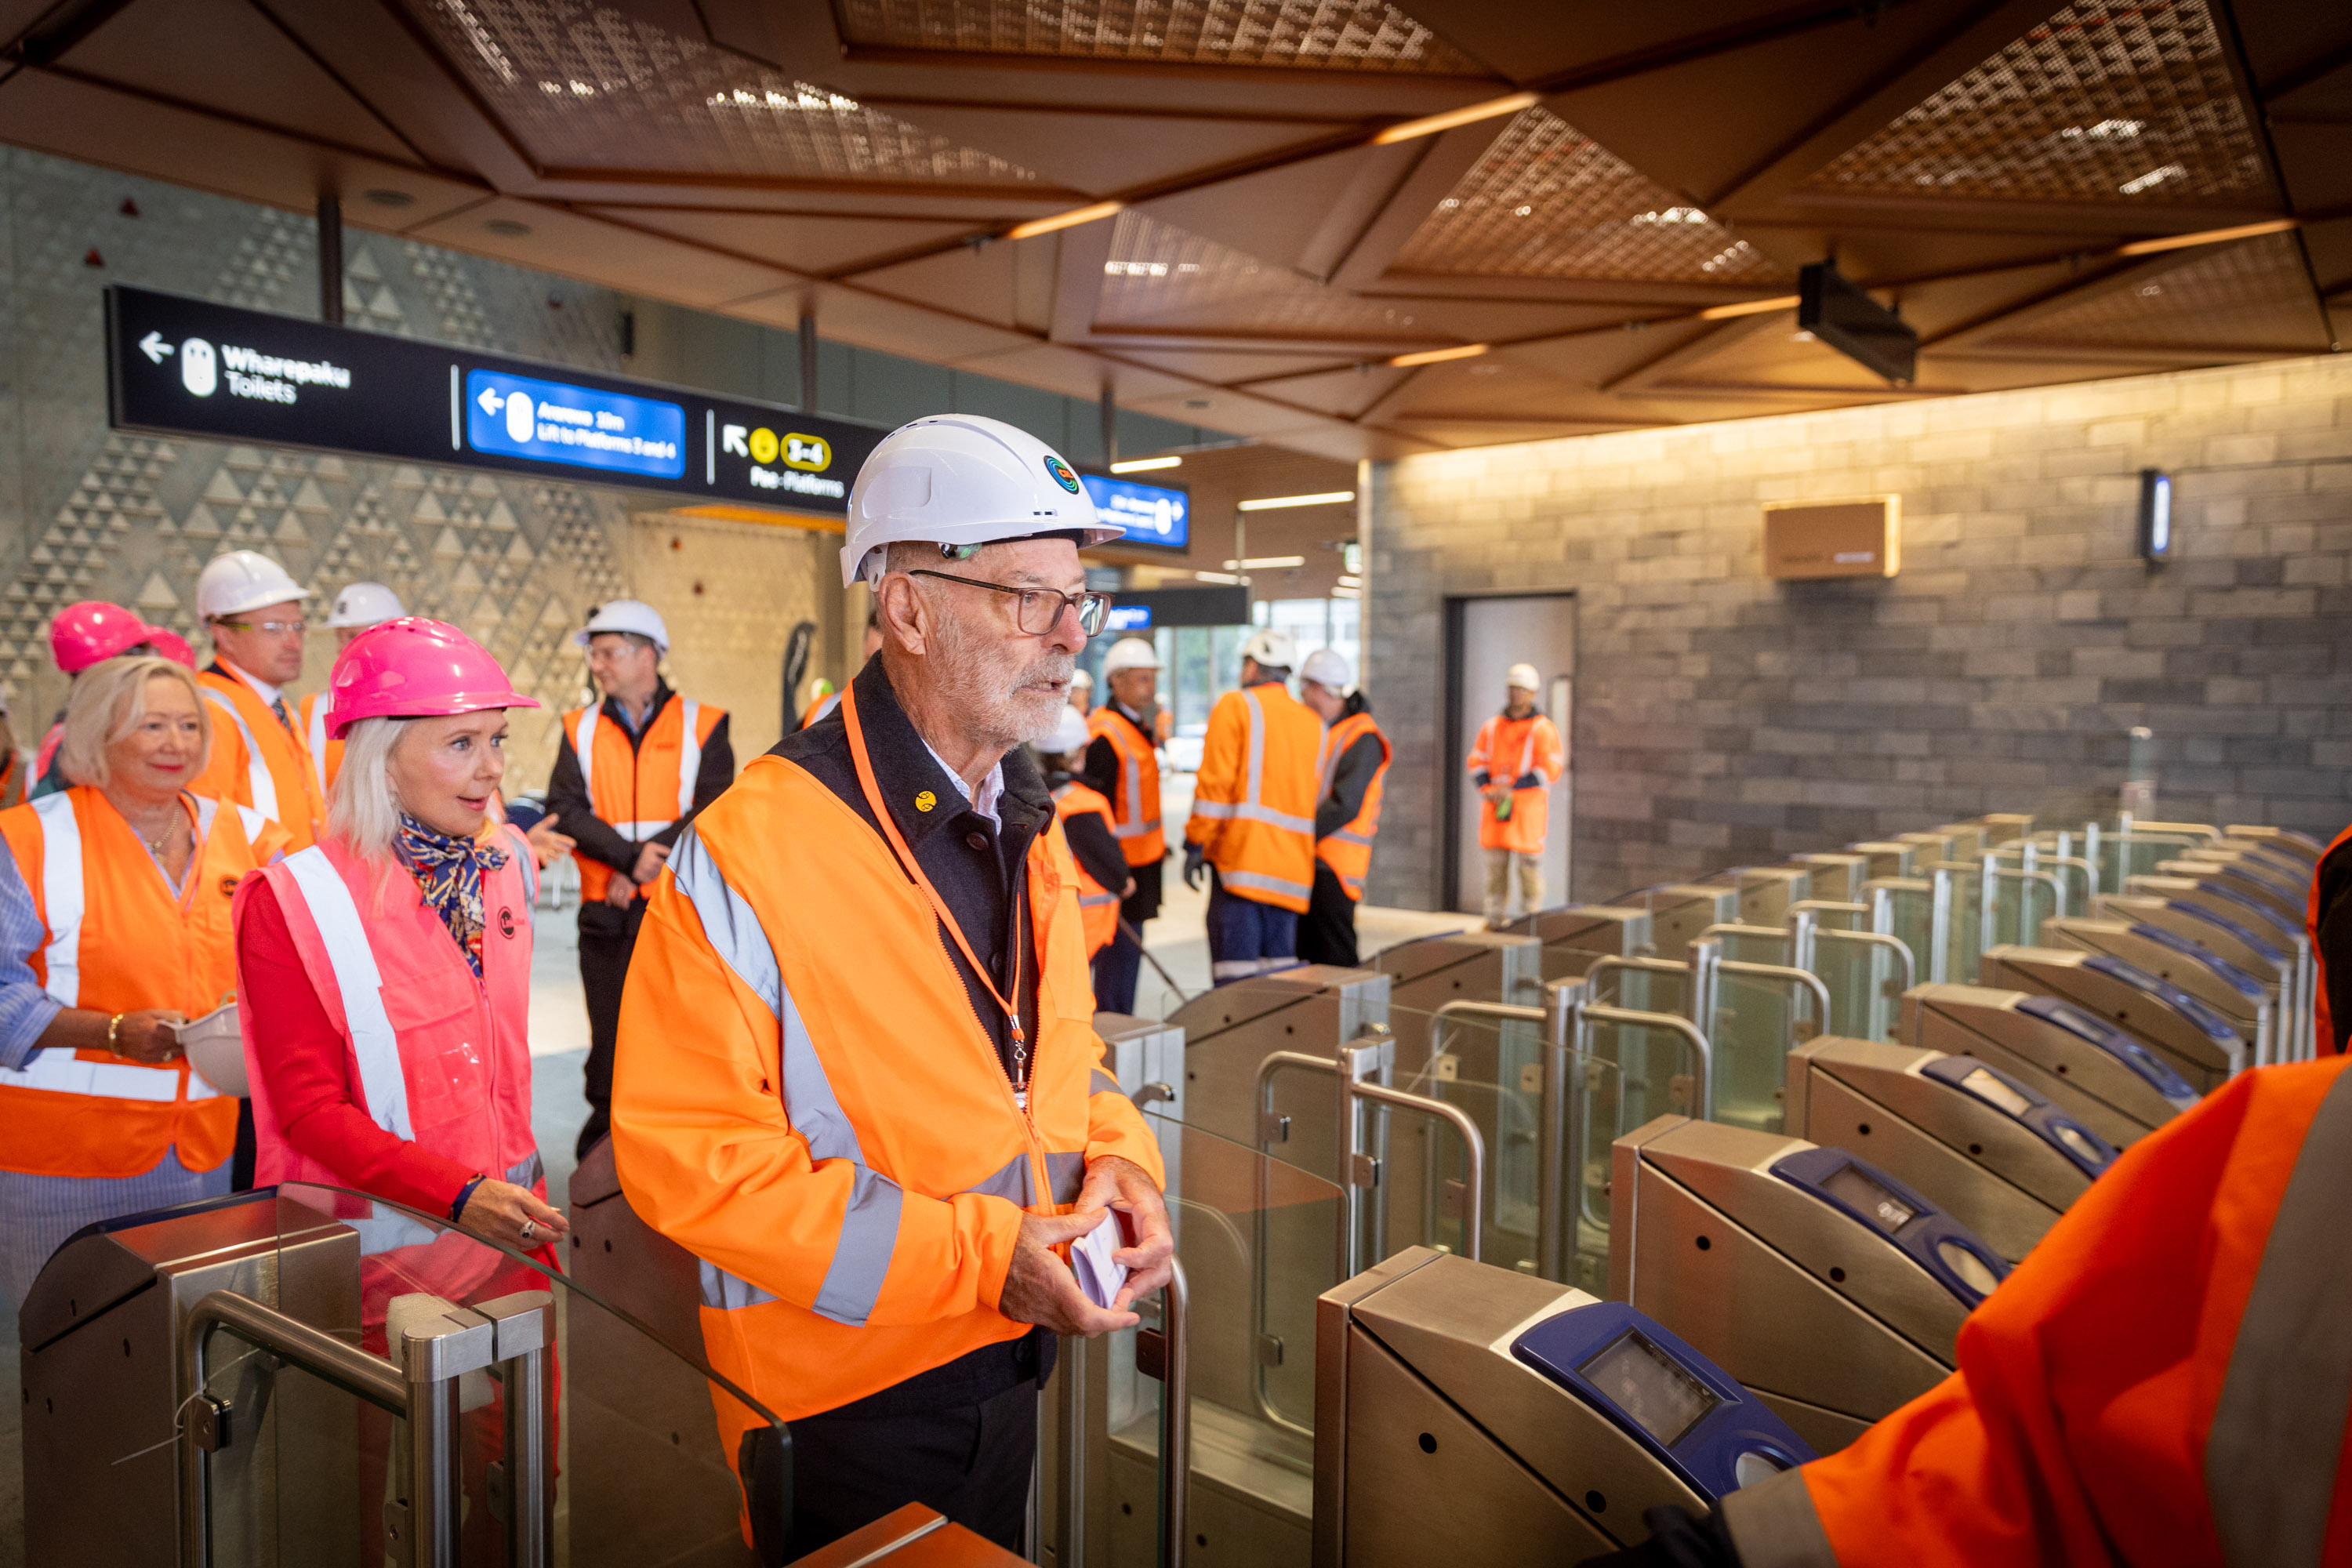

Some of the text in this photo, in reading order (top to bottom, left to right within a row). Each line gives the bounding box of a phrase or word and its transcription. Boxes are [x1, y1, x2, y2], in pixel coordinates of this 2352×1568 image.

[221, 344, 350, 389] Wharepaku
[224, 370, 297, 405] Toilets
[561, 426, 575, 445] to
[575, 428, 633, 454] Platforms
[643, 441, 666, 459] and
[750, 466, 845, 498] Pae Platforms
